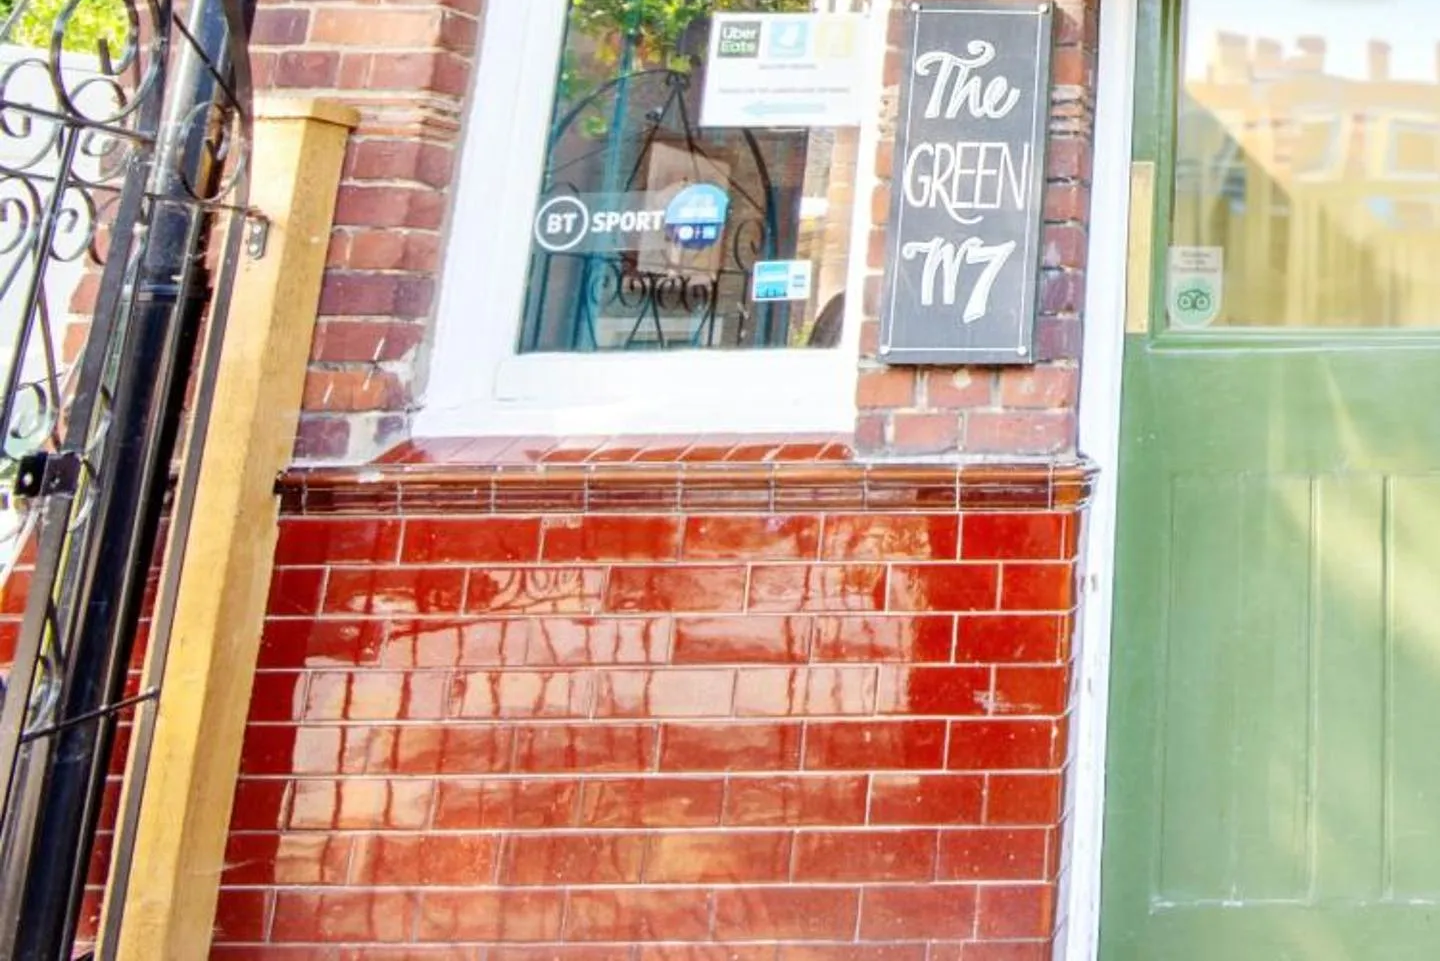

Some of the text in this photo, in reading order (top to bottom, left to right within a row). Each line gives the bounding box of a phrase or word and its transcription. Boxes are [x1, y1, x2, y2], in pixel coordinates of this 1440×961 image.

[722, 26, 757, 40] Uber
[916, 40, 1021, 119] The
[546, 210, 665, 234] BT SPORT
[905, 142, 1030, 224] GREEN
[902, 237, 1016, 323] W7
